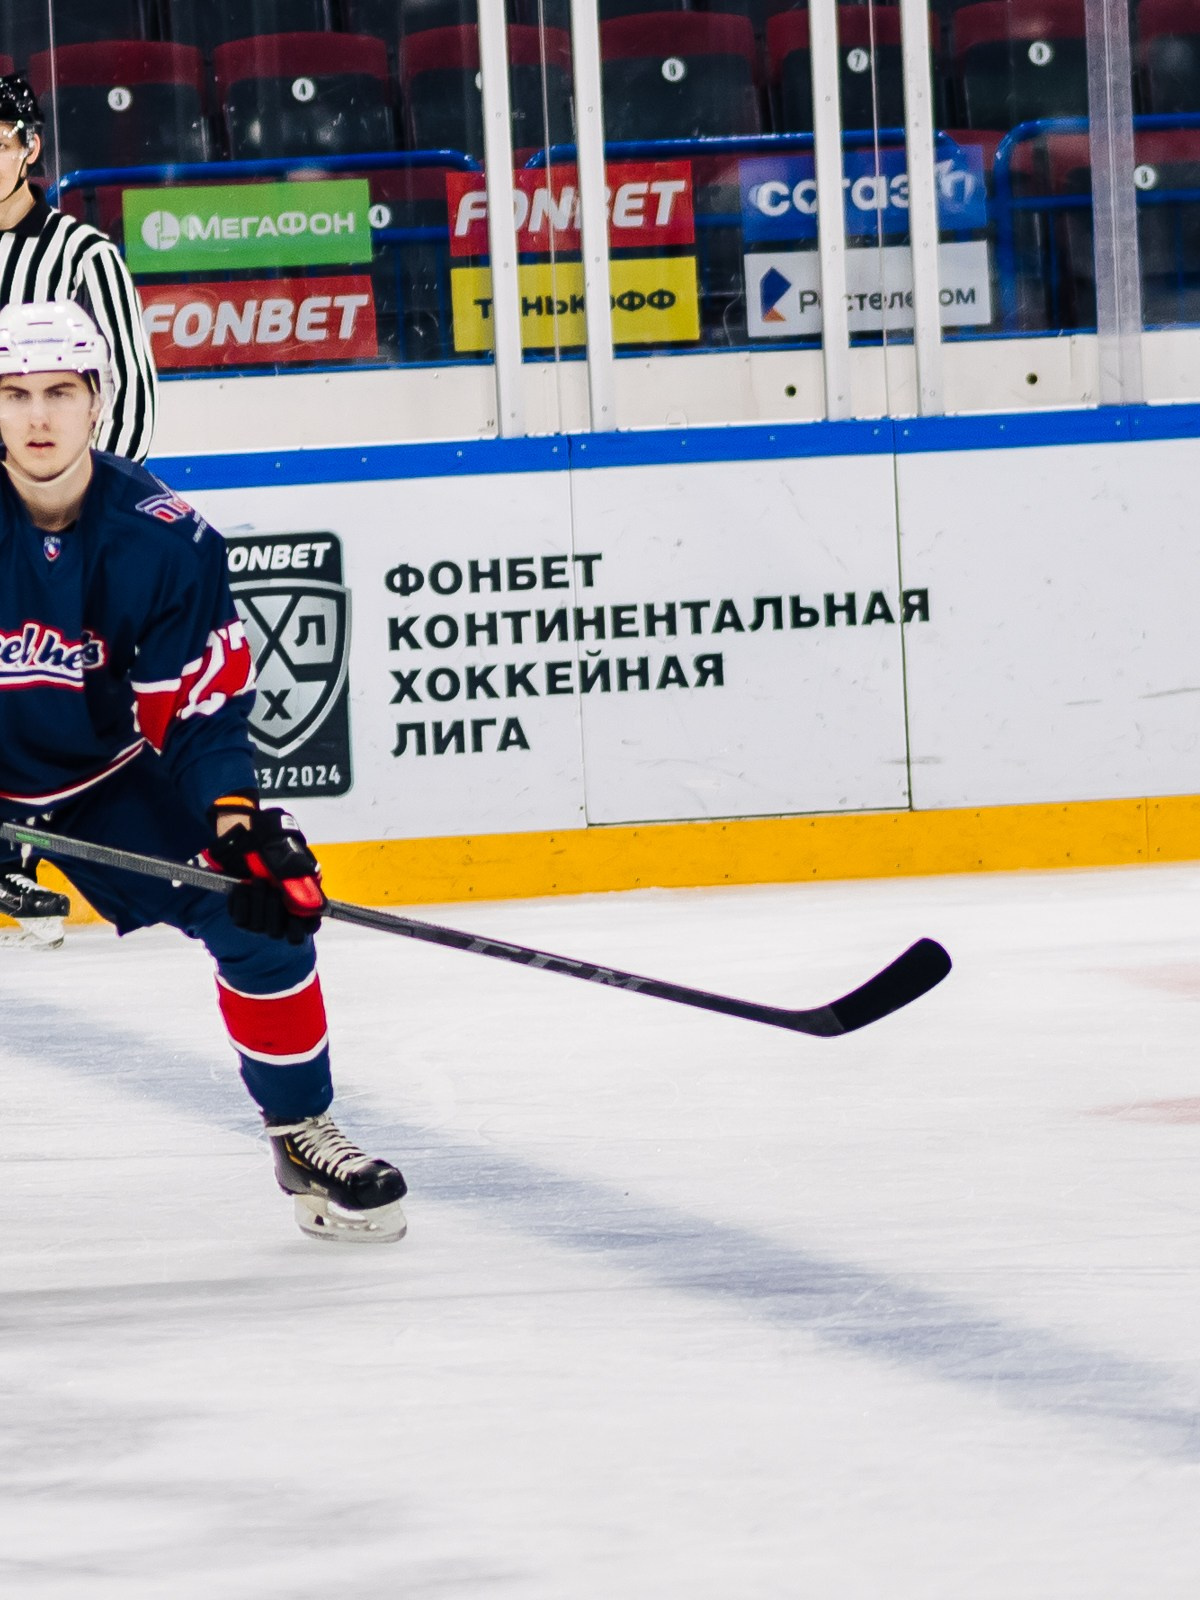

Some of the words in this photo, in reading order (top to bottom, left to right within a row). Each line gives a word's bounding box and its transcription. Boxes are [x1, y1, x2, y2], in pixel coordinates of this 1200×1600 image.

[756, 174, 910, 217] соаз
[187, 211, 355, 241] МЕГАФОН
[142, 294, 369, 348] FONBET
[227, 541, 332, 573] ONBET
[384, 552, 603, 597] ФОНБЕТ
[388, 588, 931, 651] КОНТИНЕНТАЛЬНАЯ
[389, 649, 725, 705] ХОККЕЙНАЯ
[390, 716, 531, 758] ЛИГА
